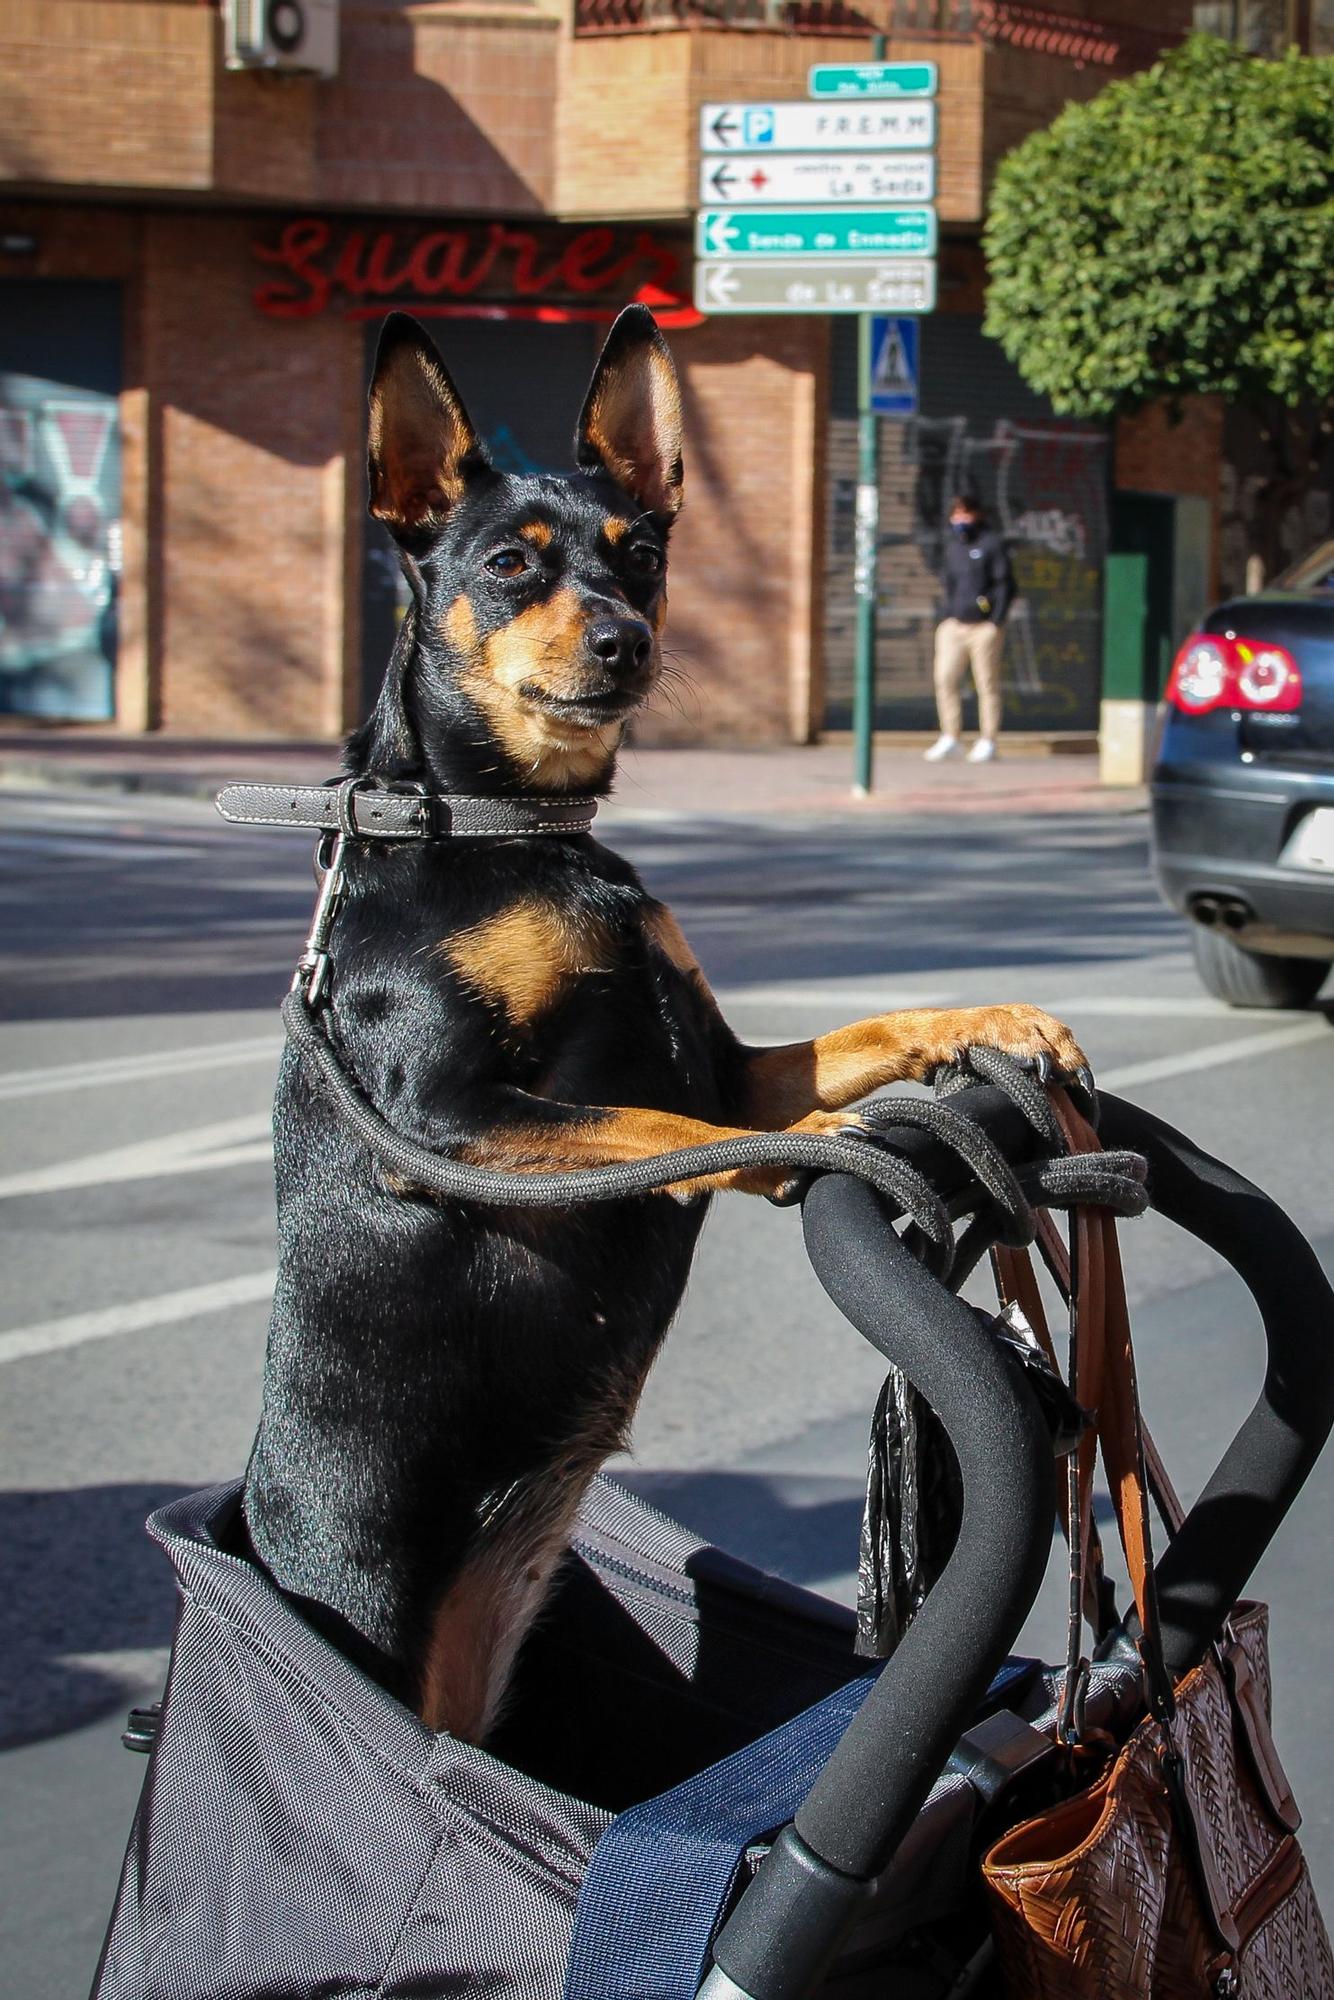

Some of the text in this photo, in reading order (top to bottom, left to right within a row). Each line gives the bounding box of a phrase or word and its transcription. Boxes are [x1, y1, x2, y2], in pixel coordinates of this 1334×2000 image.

[830, 177, 925, 195] La Seda
[814, 232, 837, 249] de
[786, 280, 815, 303] de
[825, 280, 854, 303] La
